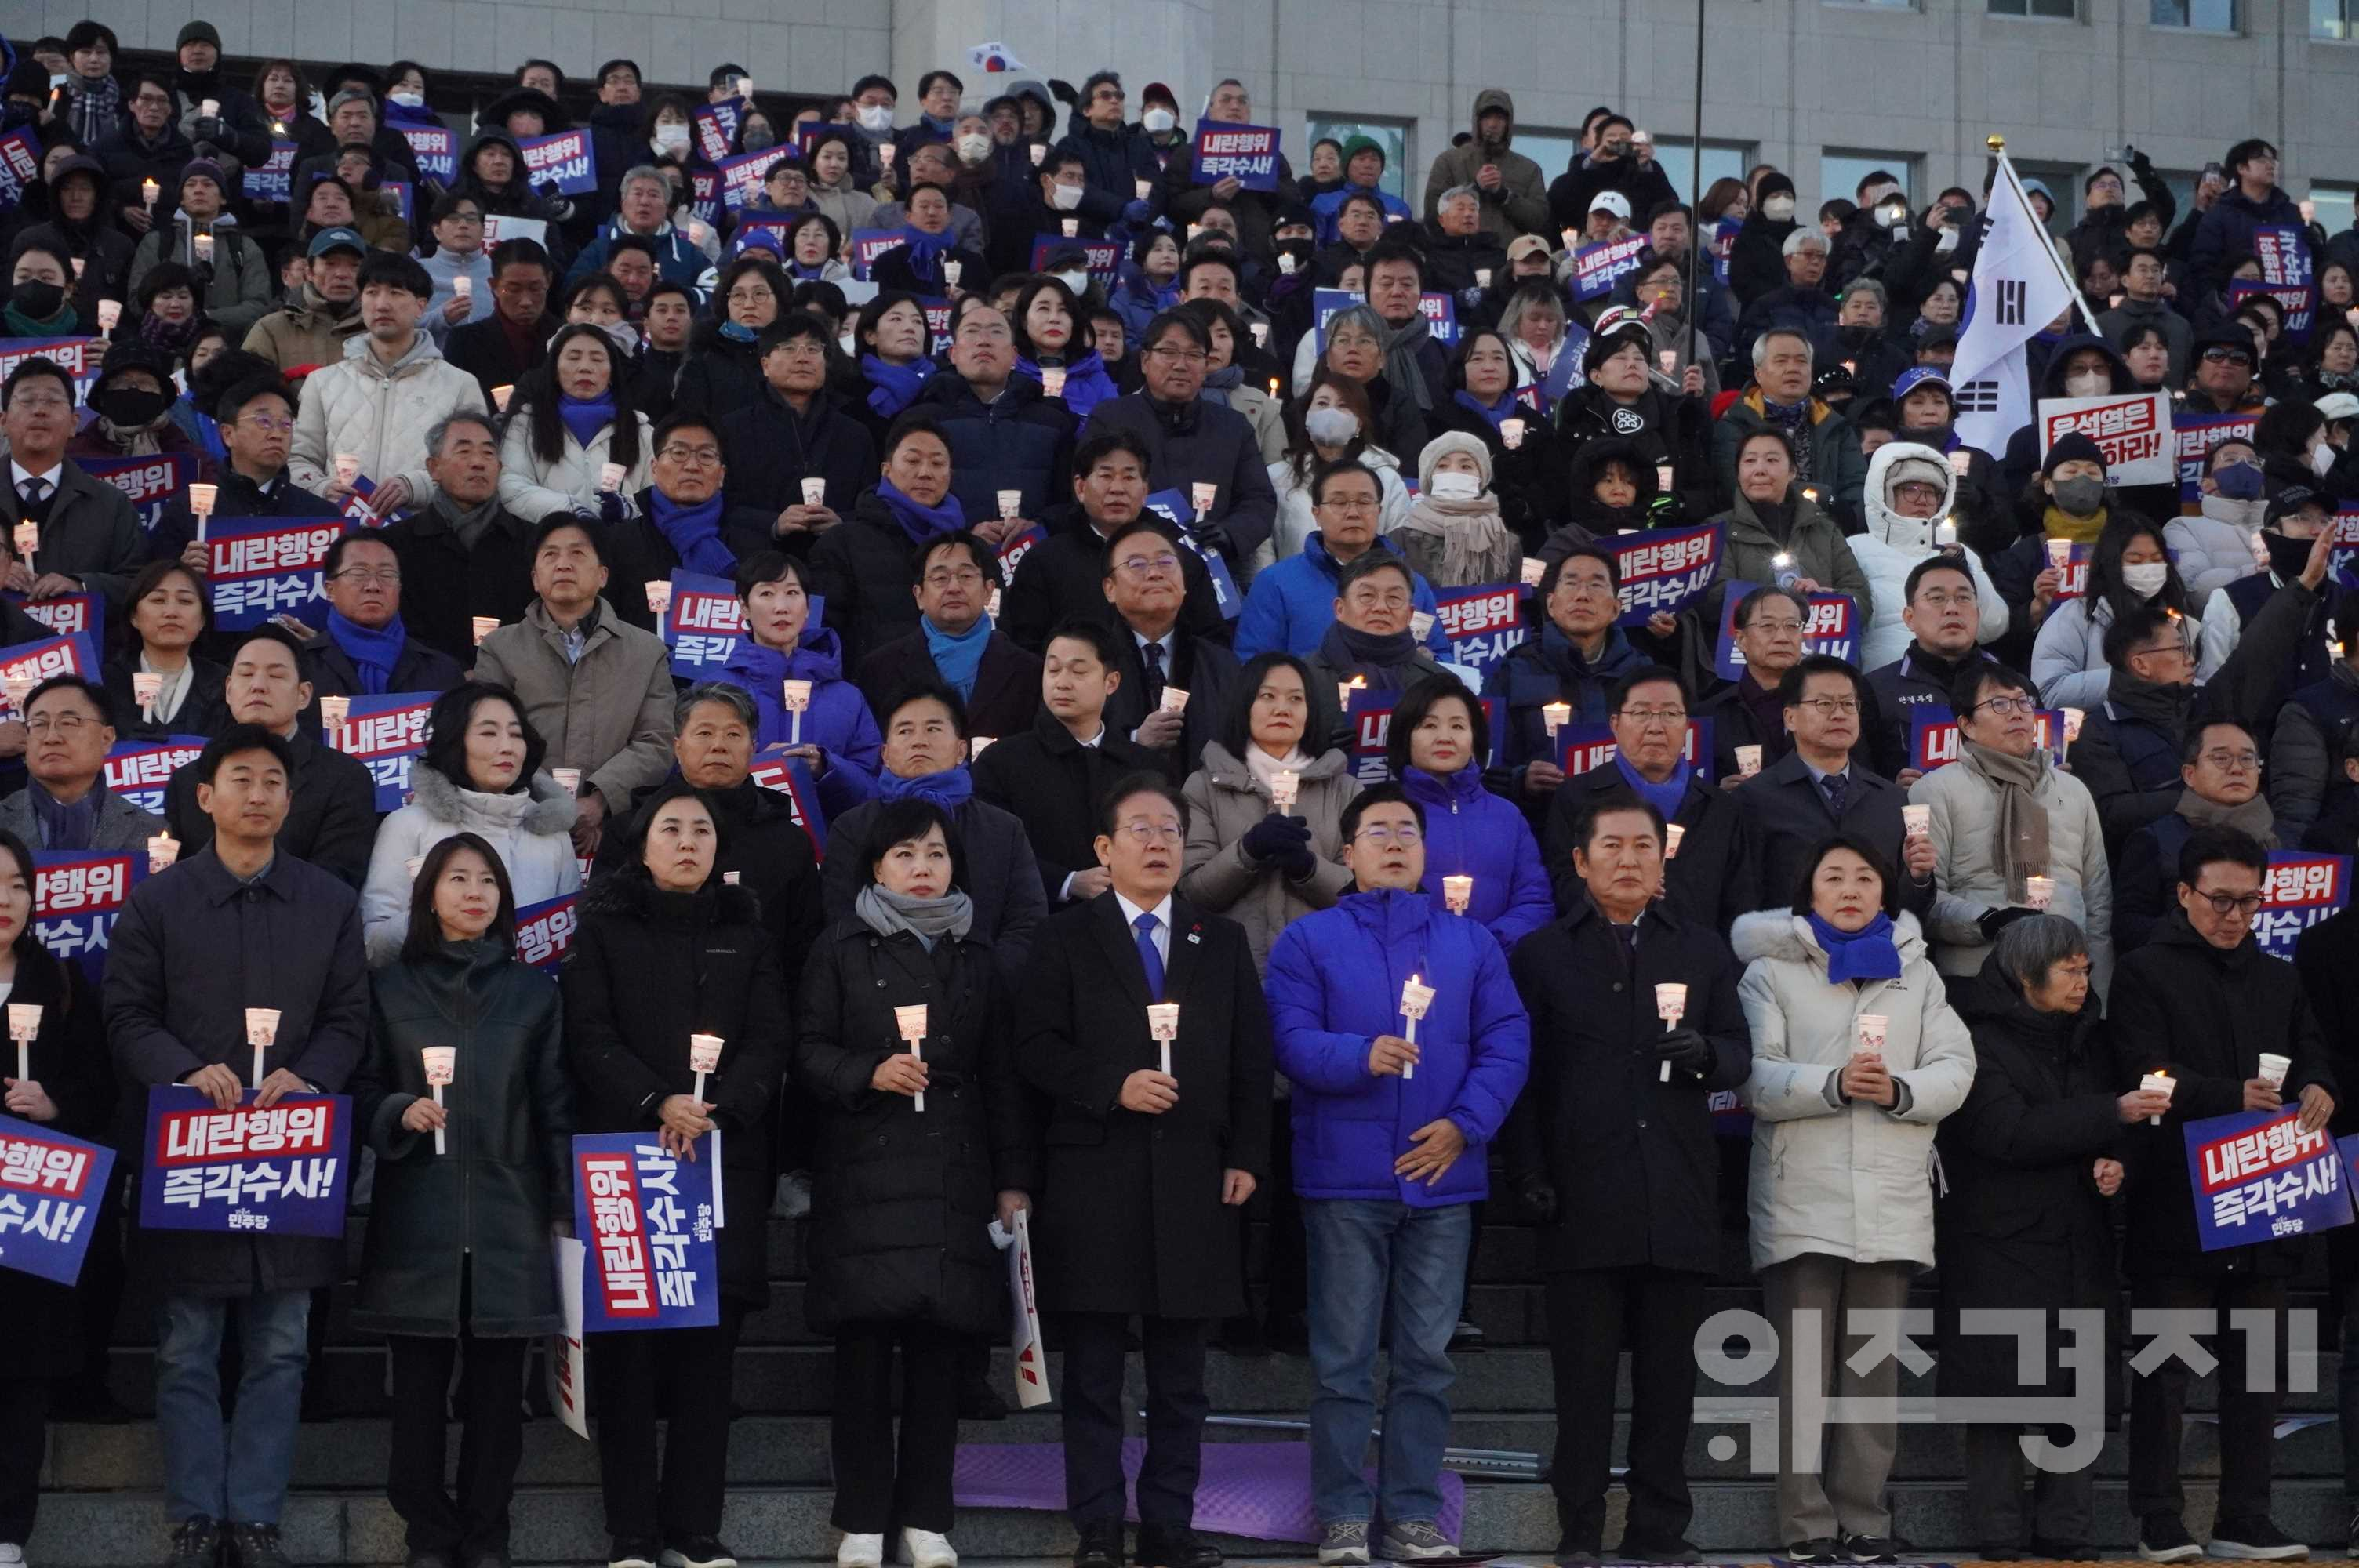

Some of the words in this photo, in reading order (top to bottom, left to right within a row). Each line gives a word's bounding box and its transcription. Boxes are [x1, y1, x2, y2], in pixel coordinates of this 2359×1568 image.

[1201, 155, 1274, 176] 즉각수사!
[1203, 132, 1271, 154] 내란행위
[1578, 237, 1646, 276] 내란행위
[165, 1105, 328, 1160] 내란행위
[2204, 1119, 2324, 1186] 내란행위
[0, 1141, 87, 1192] 행위
[162, 1158, 339, 1209] 즉각수사!
[2212, 1149, 2340, 1228] 즉각수사!
[227, 1214, 270, 1230] 민주당
[585, 1160, 657, 1312] 내란행위
[634, 1143, 697, 1308] 즉각수사!
[698, 1203, 713, 1243] 민주당
[2270, 1218, 2305, 1237] 민주당
